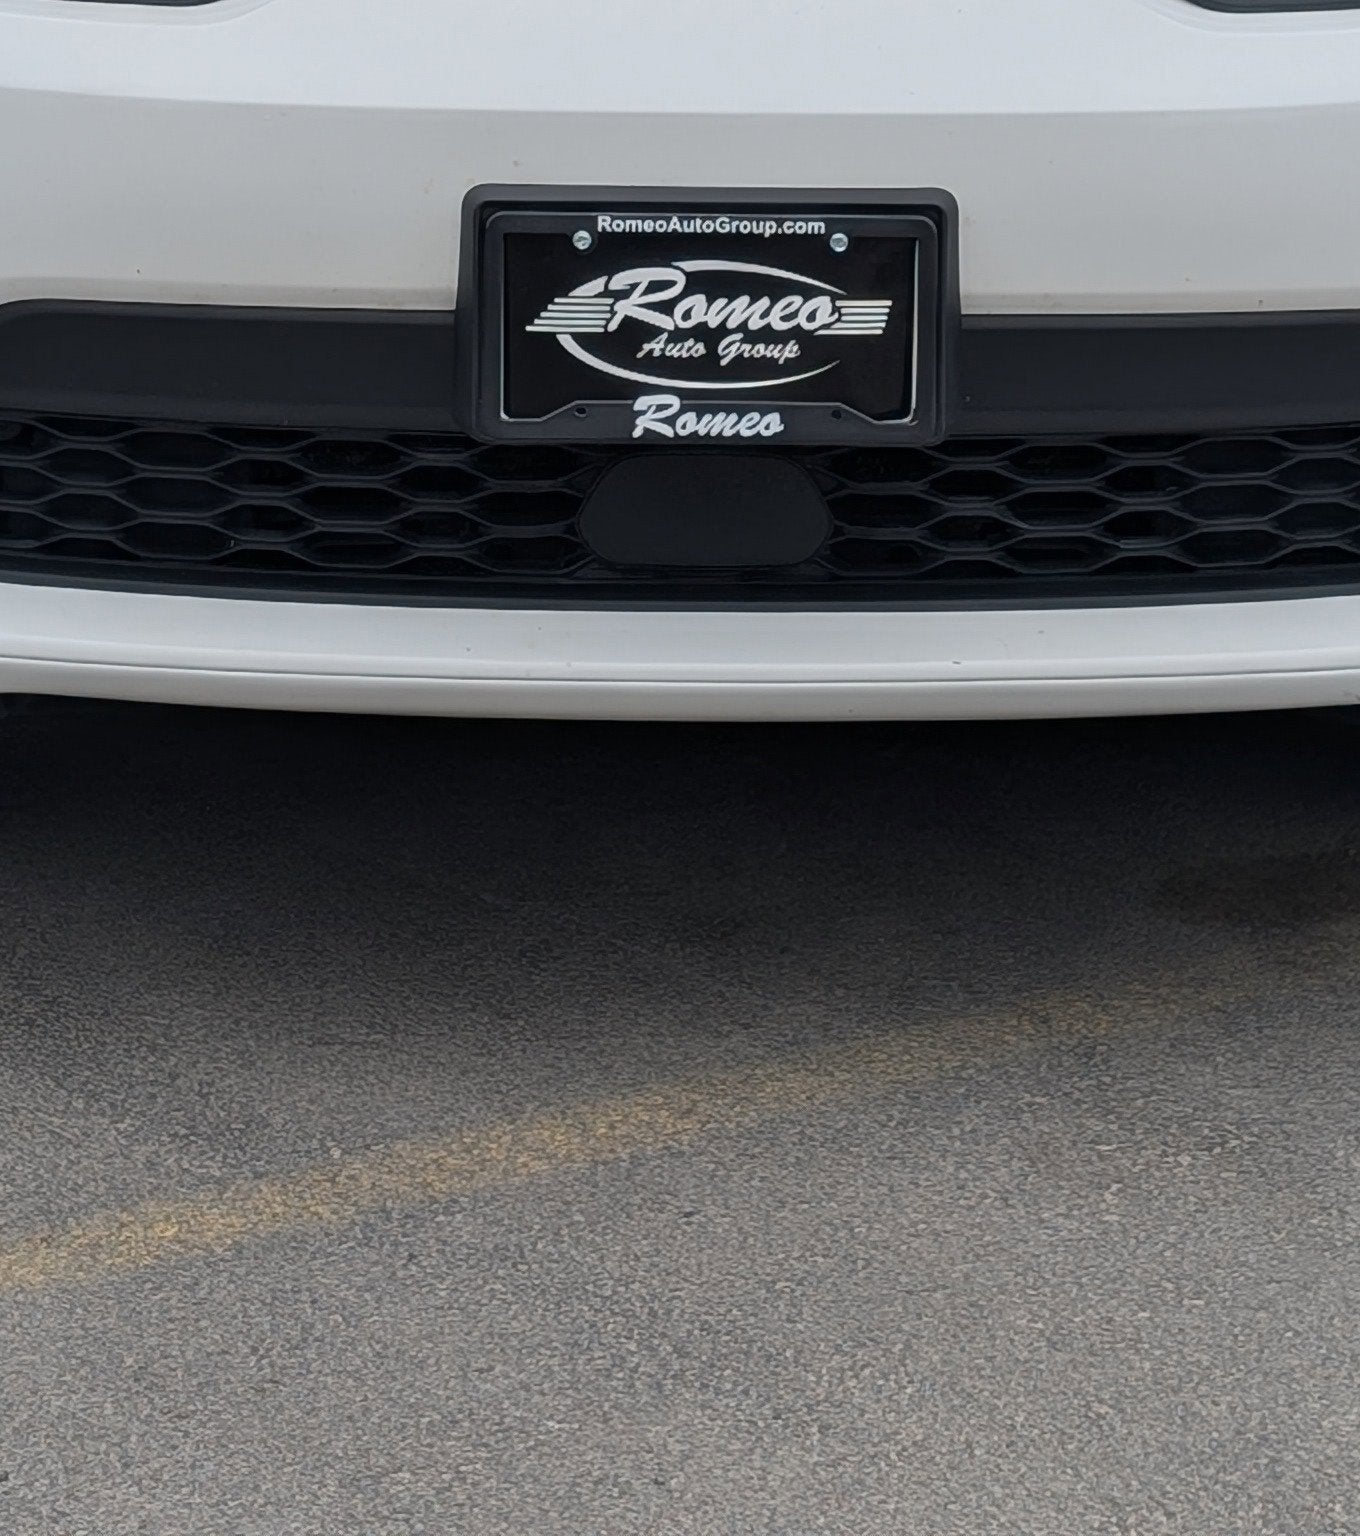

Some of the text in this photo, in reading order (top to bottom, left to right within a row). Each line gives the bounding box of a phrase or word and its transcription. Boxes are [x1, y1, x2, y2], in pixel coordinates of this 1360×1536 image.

[597, 215, 826, 236] RomeoAutoGroup.com
[607, 267, 839, 332] Romeo
[636, 333, 801, 366] Auto Group
[632, 394, 784, 438] Romeo
